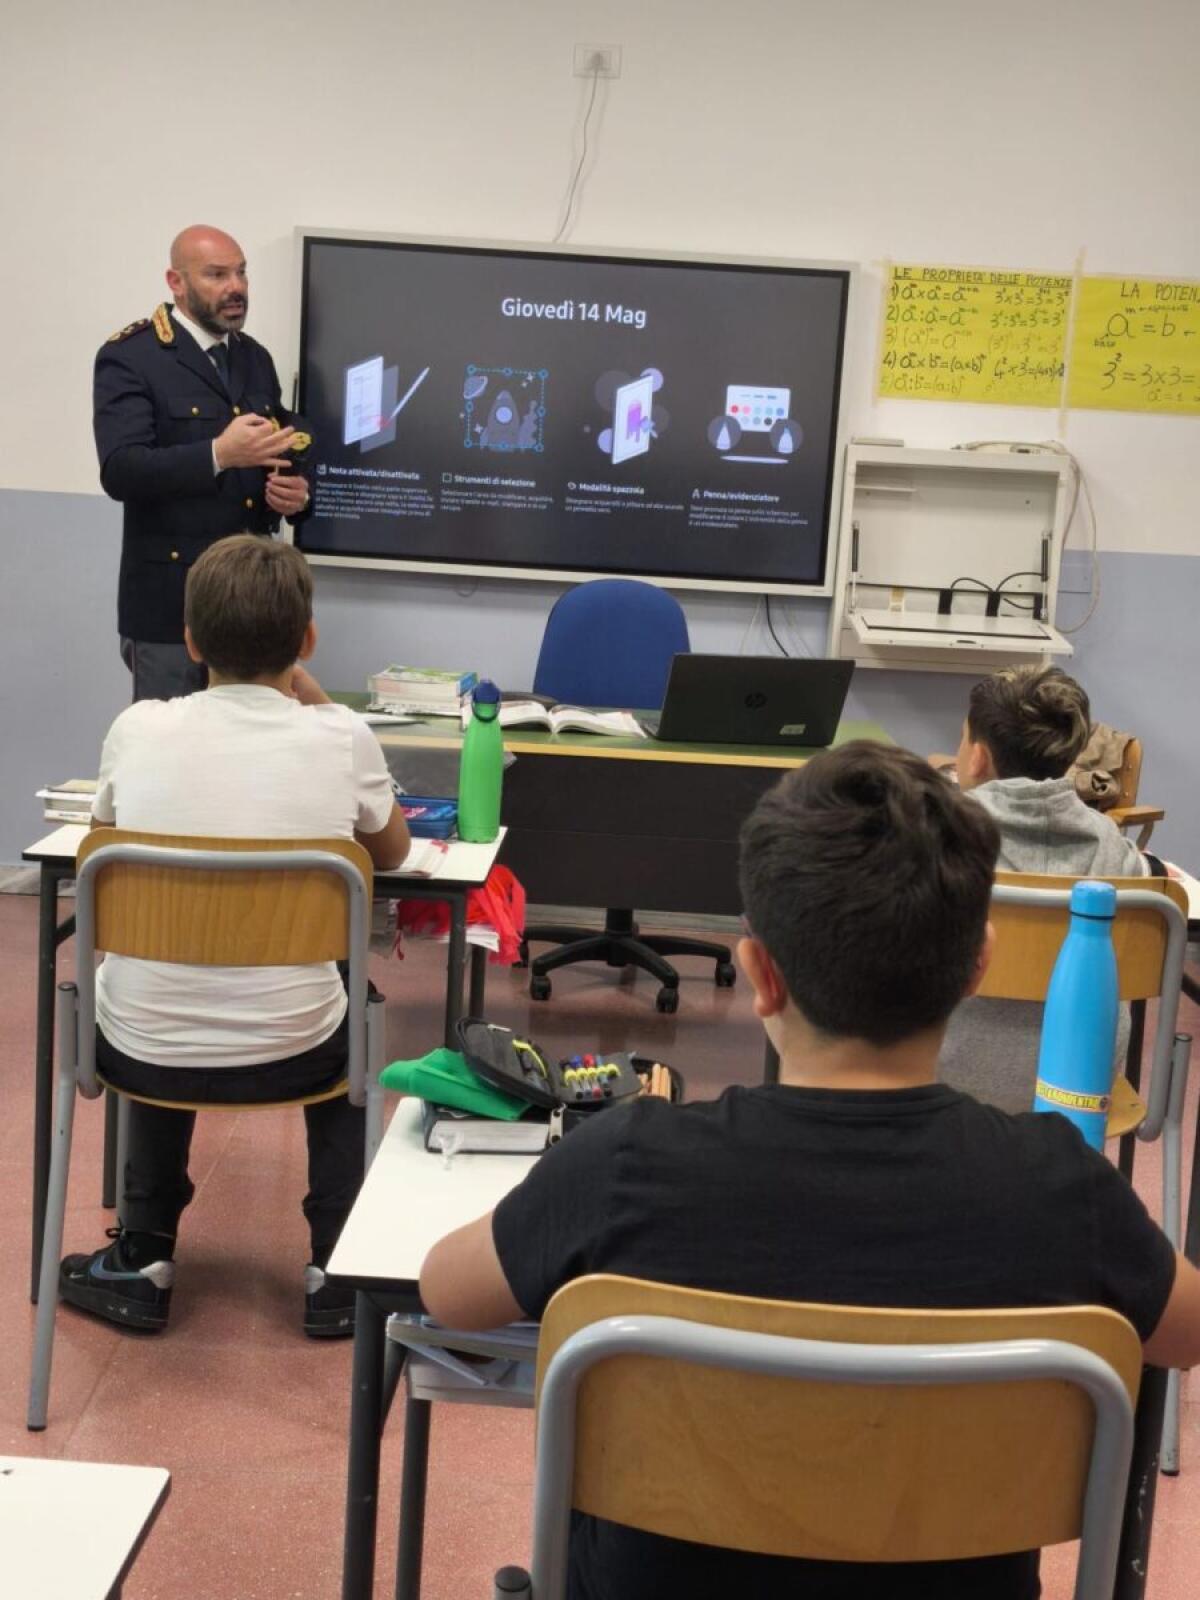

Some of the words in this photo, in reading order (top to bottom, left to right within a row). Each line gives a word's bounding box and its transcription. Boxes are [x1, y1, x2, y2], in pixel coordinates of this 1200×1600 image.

[893, 266, 912, 280] LE
[1121, 281, 1140, 298] LA
[501, 298, 574, 320] Giovedì
[578, 303, 600, 321] 14
[605, 304, 647, 329] Mag
[454, 474, 492, 485] Strumenti
